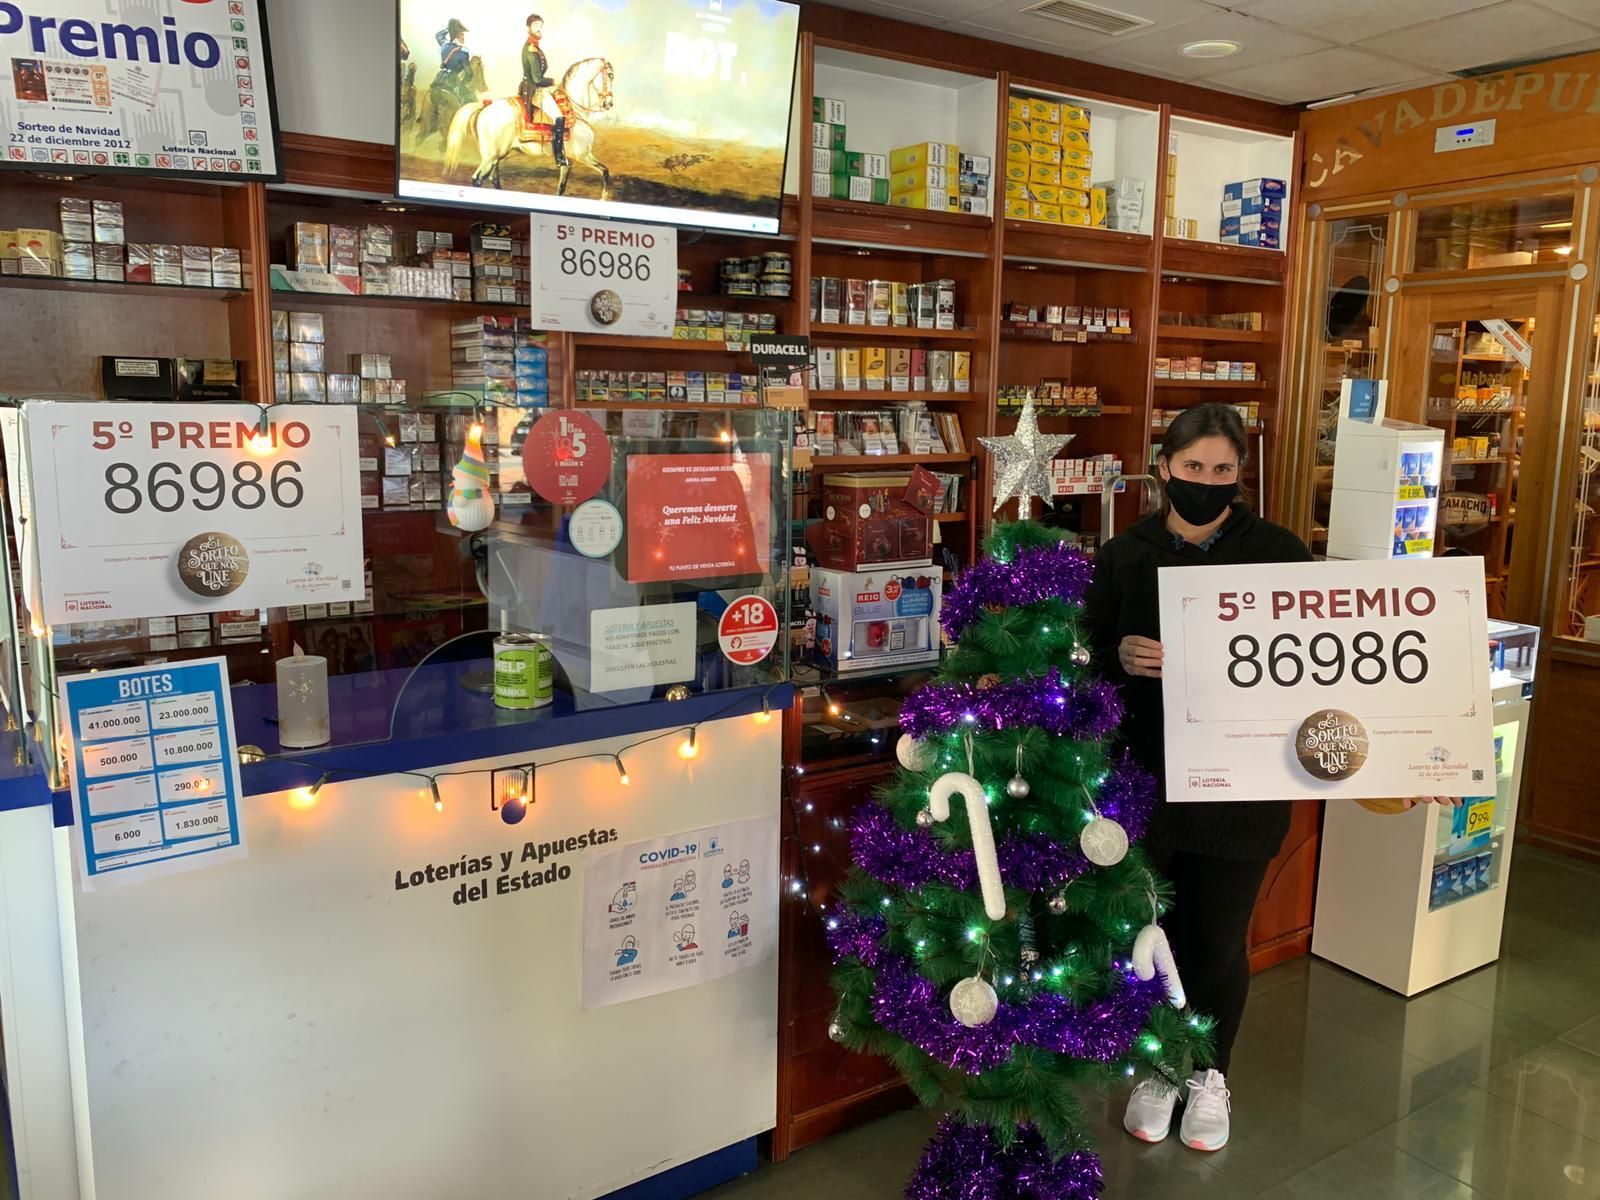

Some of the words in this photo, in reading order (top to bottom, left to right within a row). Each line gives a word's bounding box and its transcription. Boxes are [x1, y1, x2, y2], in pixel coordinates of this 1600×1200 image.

[0, 1, 220, 69] Premio
[17, 121, 56, 133] Sorteo
[58, 124, 72, 134] de
[76, 125, 120, 137] Navidad
[10, 133, 25, 143] 22
[28, 135, 42, 144] de
[45, 135, 101, 148] diciembre
[104, 139, 131, 149] 2012
[197, 147, 237, 156] Nacional
[557, 224, 576, 241] 5º
[581, 227, 655, 249] PREMIO
[560, 247, 651, 281] 86986
[752, 344, 807, 356] DURACELL
[92, 420, 134, 450] 5º
[150, 420, 311, 450] PREMIO
[104, 460, 304, 514] 86986
[663, 505, 703, 516] Queremos
[704, 504, 738, 512] desearte
[664, 518, 680, 526] una
[682, 516, 702, 525] Feliz
[188, 545, 238, 568] SORTEO
[200, 562, 218, 572] QUE
[220, 558, 238, 570] NOS
[858, 594, 879, 602] REIG
[1217, 590, 1256, 622] 5º
[1271, 586, 1436, 620] PREMIO
[732, 603, 764, 625] +18
[854, 605, 882, 616] BLUE
[1227, 630, 1429, 688] 86986
[119, 674, 173, 698] BOTES
[159, 706, 209, 720] 23.000.000
[1318, 712, 1341, 730] EL
[88, 715, 140, 730] 41.000.000
[1306, 724, 1357, 748] SORTEO
[164, 742, 213, 756] 10.800.000
[1319, 742, 1336, 752] QUE
[1339, 739, 1357, 752] NOS
[100, 752, 138, 766] 500.000
[1314, 752, 1348, 774] UNE
[176, 815, 219, 830] 1.830.000
[114, 830, 141, 842] 6.000
[394, 854, 493, 890] Loterías
[500, 850, 513, 872] y
[520, 828, 618, 864] Apuestas
[640, 844, 697, 864] COVID-19
[452, 878, 488, 906] del
[496, 862, 572, 895] Estado
